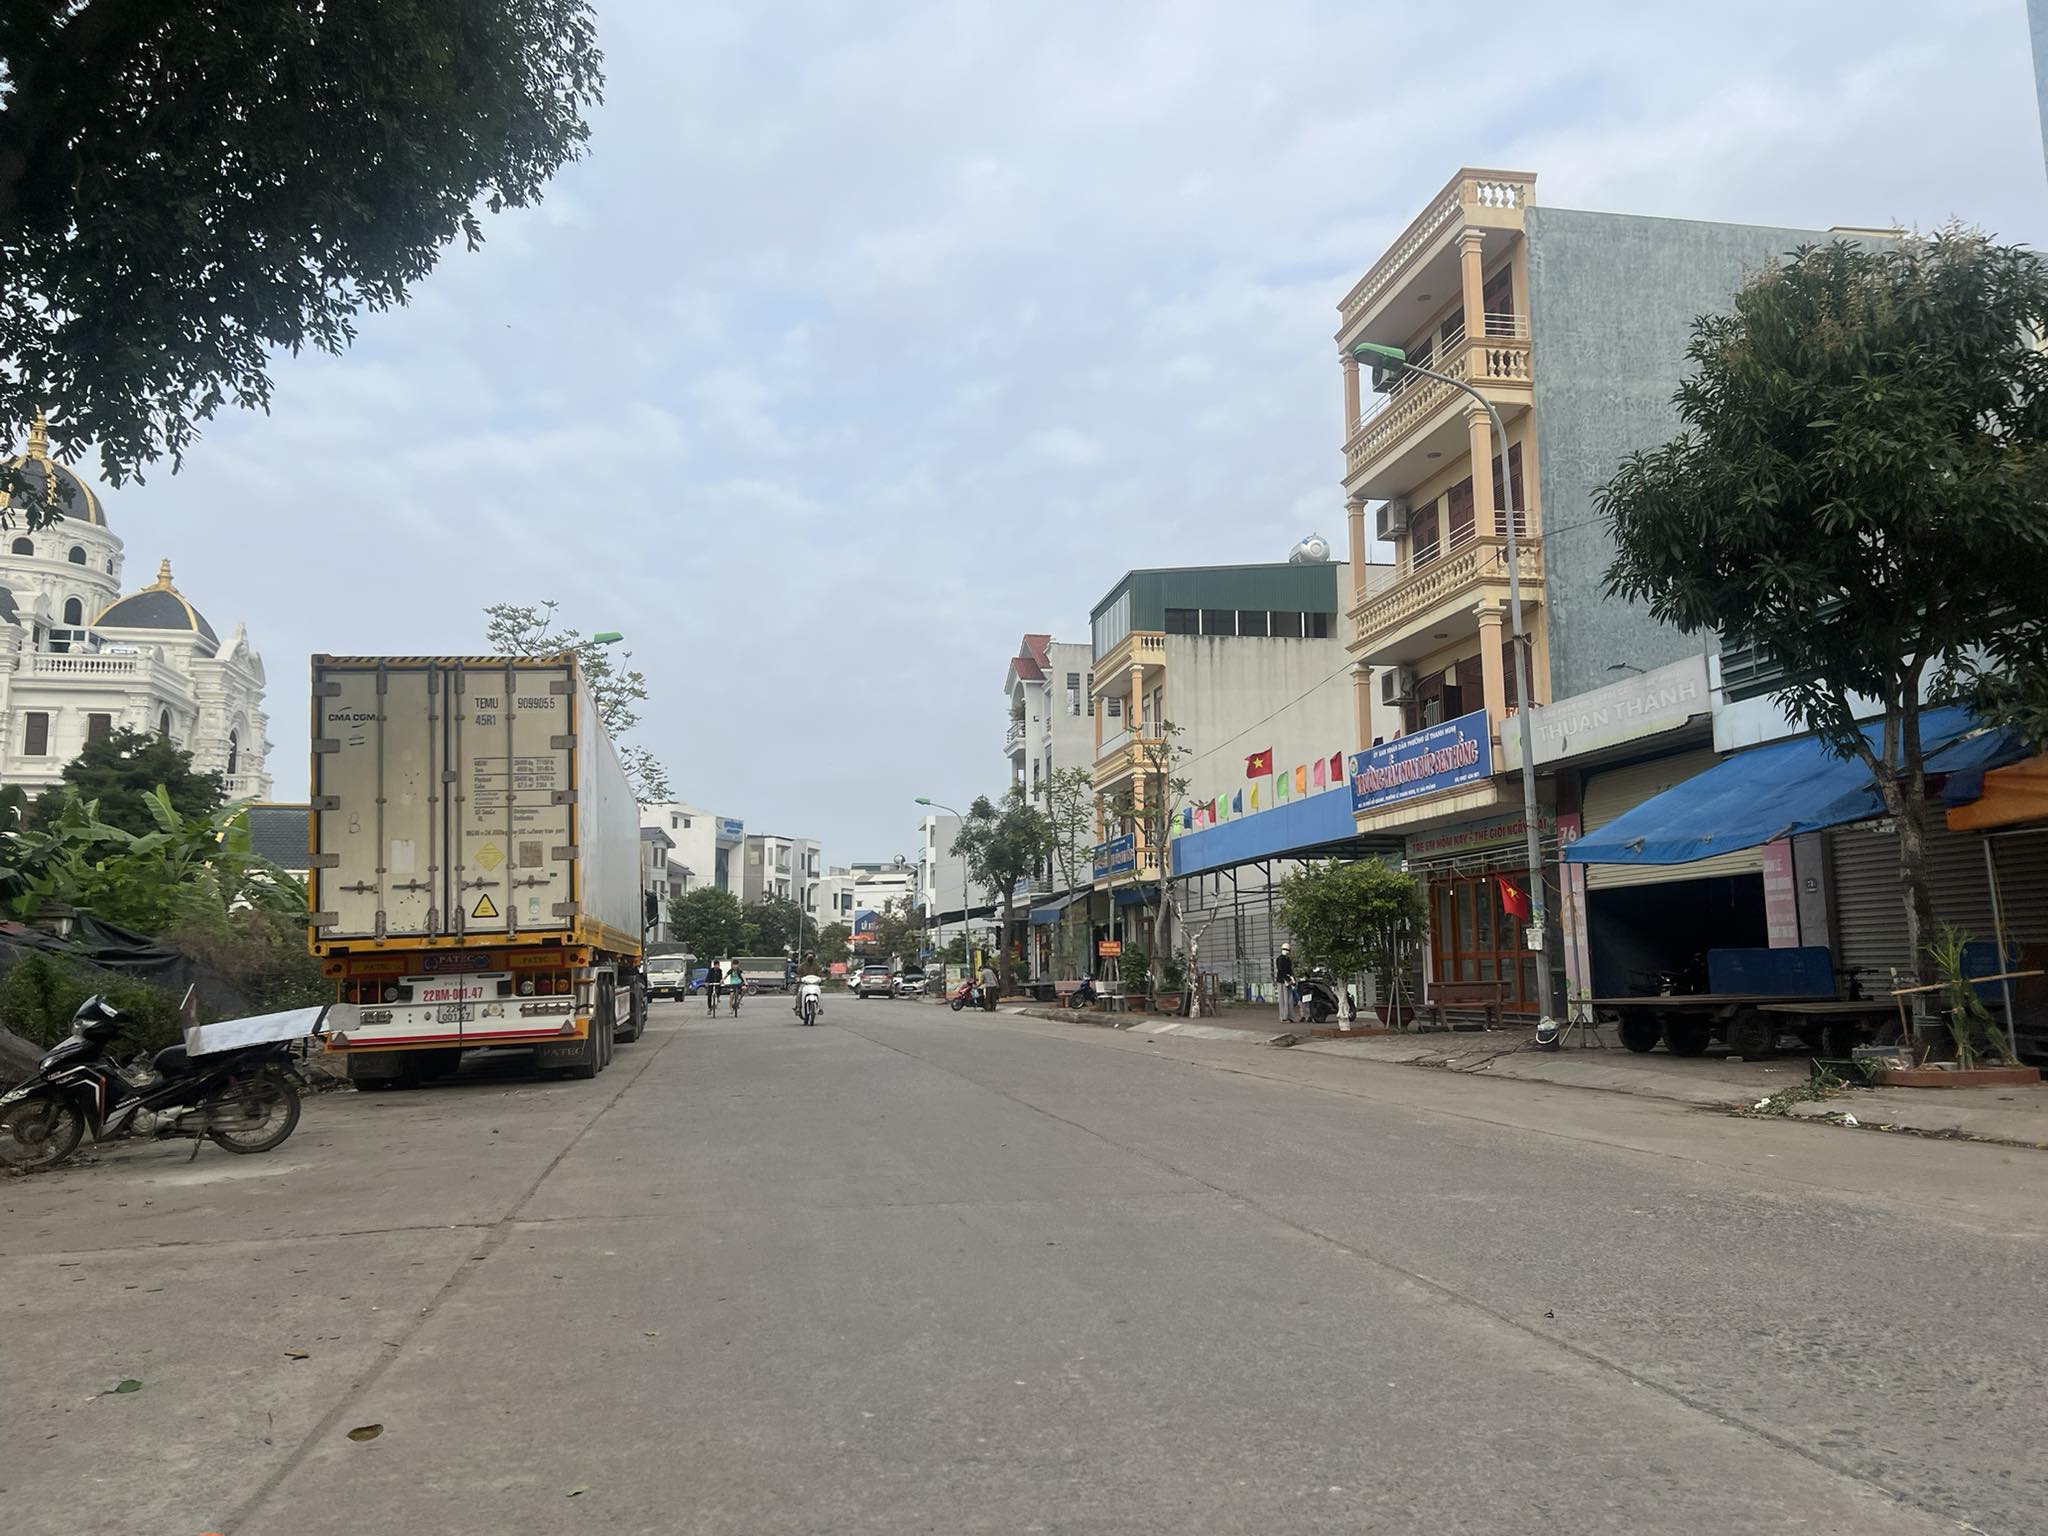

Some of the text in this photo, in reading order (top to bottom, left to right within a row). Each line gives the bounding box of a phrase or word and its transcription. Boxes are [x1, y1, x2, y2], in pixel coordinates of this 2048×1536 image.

[474, 697, 556, 709] TEMU 9099055
[328, 713, 351, 721] CMA
[1560, 826, 1577, 843] 76
